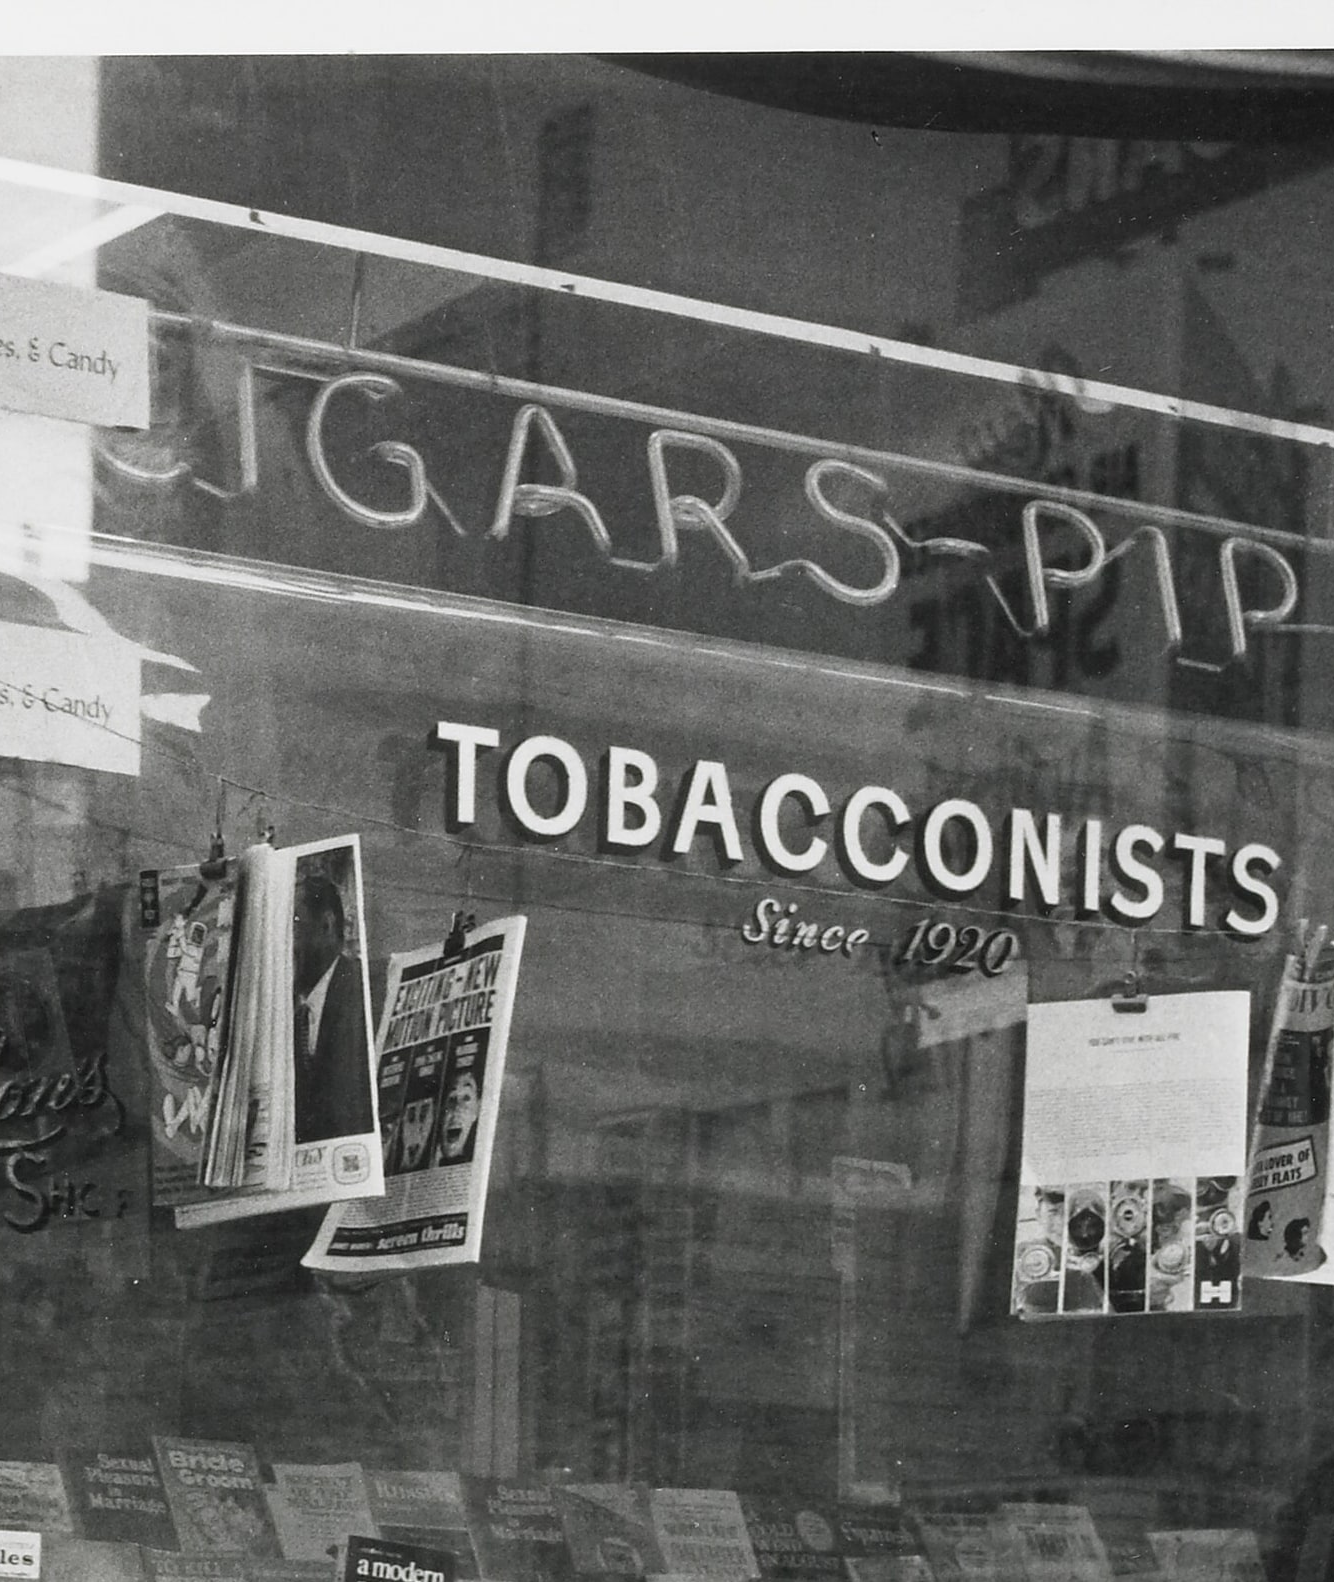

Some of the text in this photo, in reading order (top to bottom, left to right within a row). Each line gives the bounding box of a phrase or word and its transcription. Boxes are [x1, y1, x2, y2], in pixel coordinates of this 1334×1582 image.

[27, 334, 42, 363] &
[48, 341, 121, 381] Candy
[43, 689, 114, 722] Candy
[433, 720, 1282, 936] TOBACCONISTS
[743, 899, 1020, 974] Since 1920
[357, 1560, 369, 1575] a
